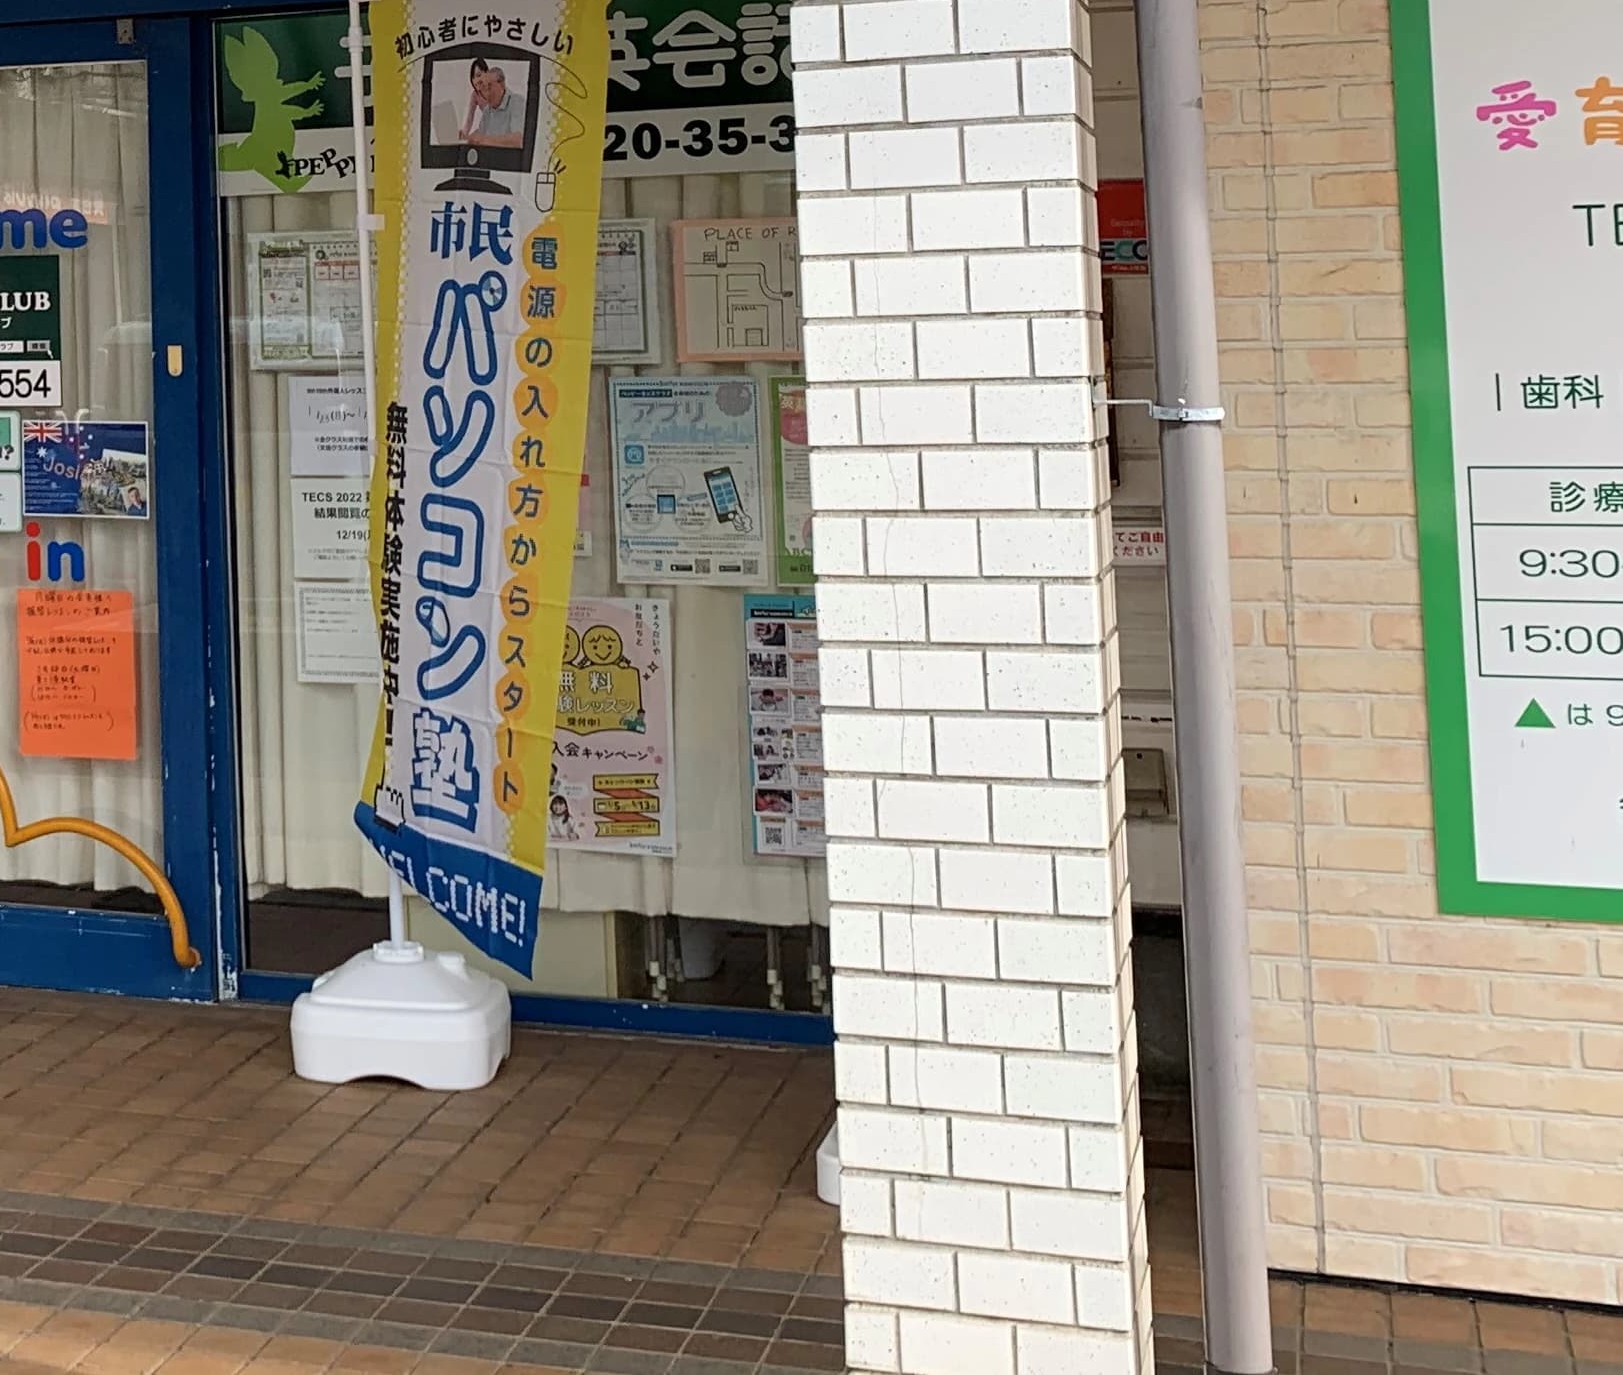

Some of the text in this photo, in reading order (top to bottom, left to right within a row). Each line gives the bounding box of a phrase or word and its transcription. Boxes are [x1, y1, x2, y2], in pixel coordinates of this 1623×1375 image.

[395, 14, 573, 59] 初心者にやさしい
[429, 201, 514, 266] 市民
[703, 227, 753, 241] PLACE
[761, 227, 780, 239] OF
[1520, 373, 1604, 409] 歯科
[301, 491, 363, 503] TECS 2022
[502, 236, 559, 804] 電源の入れ方からスタート
[25, 521, 85, 582] in
[411, 270, 508, 834] パソコン塾
[1519, 548, 1621, 578] 9:30
[1500, 624, 1623, 655] 15:00
[369, 828, 526, 948] ELCOME!
